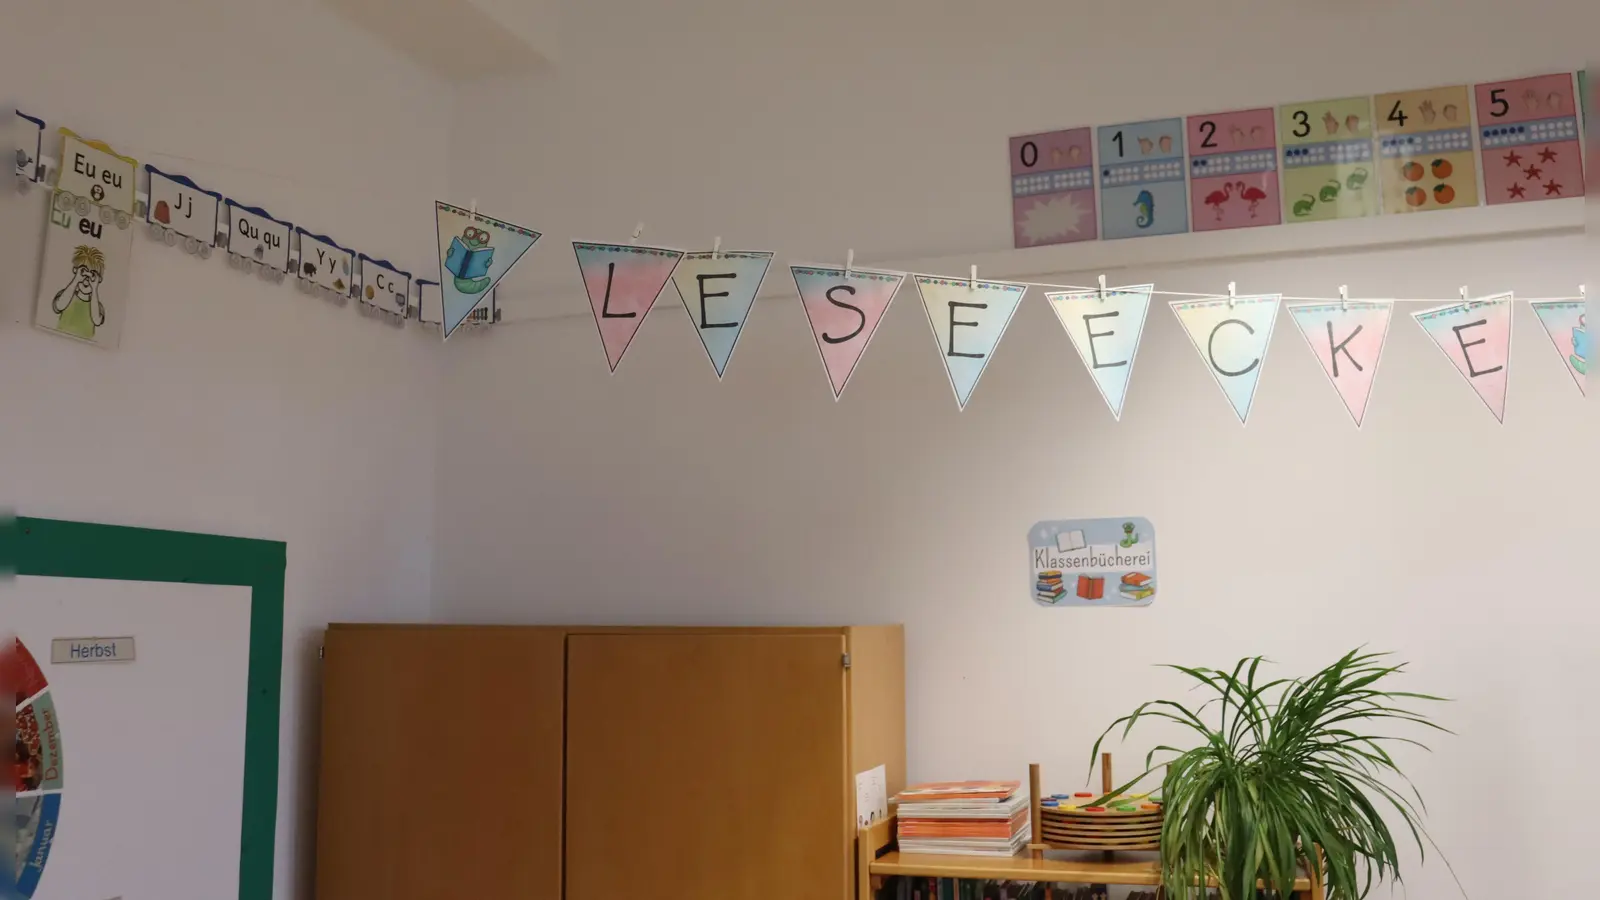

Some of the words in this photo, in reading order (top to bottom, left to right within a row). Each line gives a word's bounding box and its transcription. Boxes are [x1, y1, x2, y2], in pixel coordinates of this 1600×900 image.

[1387, 100, 1408, 127] 4
[1490, 89, 1510, 117] 5
[1200, 121, 1218, 148] 2
[1292, 110, 1311, 137] 3
[1020, 141, 1038, 167] 0
[1112, 131, 1124, 158] 1
[74, 152, 96, 179] Eu
[102, 169, 122, 189] eu
[78, 217, 102, 239] eu
[238, 218, 259, 240] Qu
[263, 232, 280, 250] qu
[1035, 544, 1151, 569] Klassenbücherei
[70, 642, 117, 659] Herbst
[42, 708, 60, 780] Dezember
[29, 818, 53, 872] Januar
